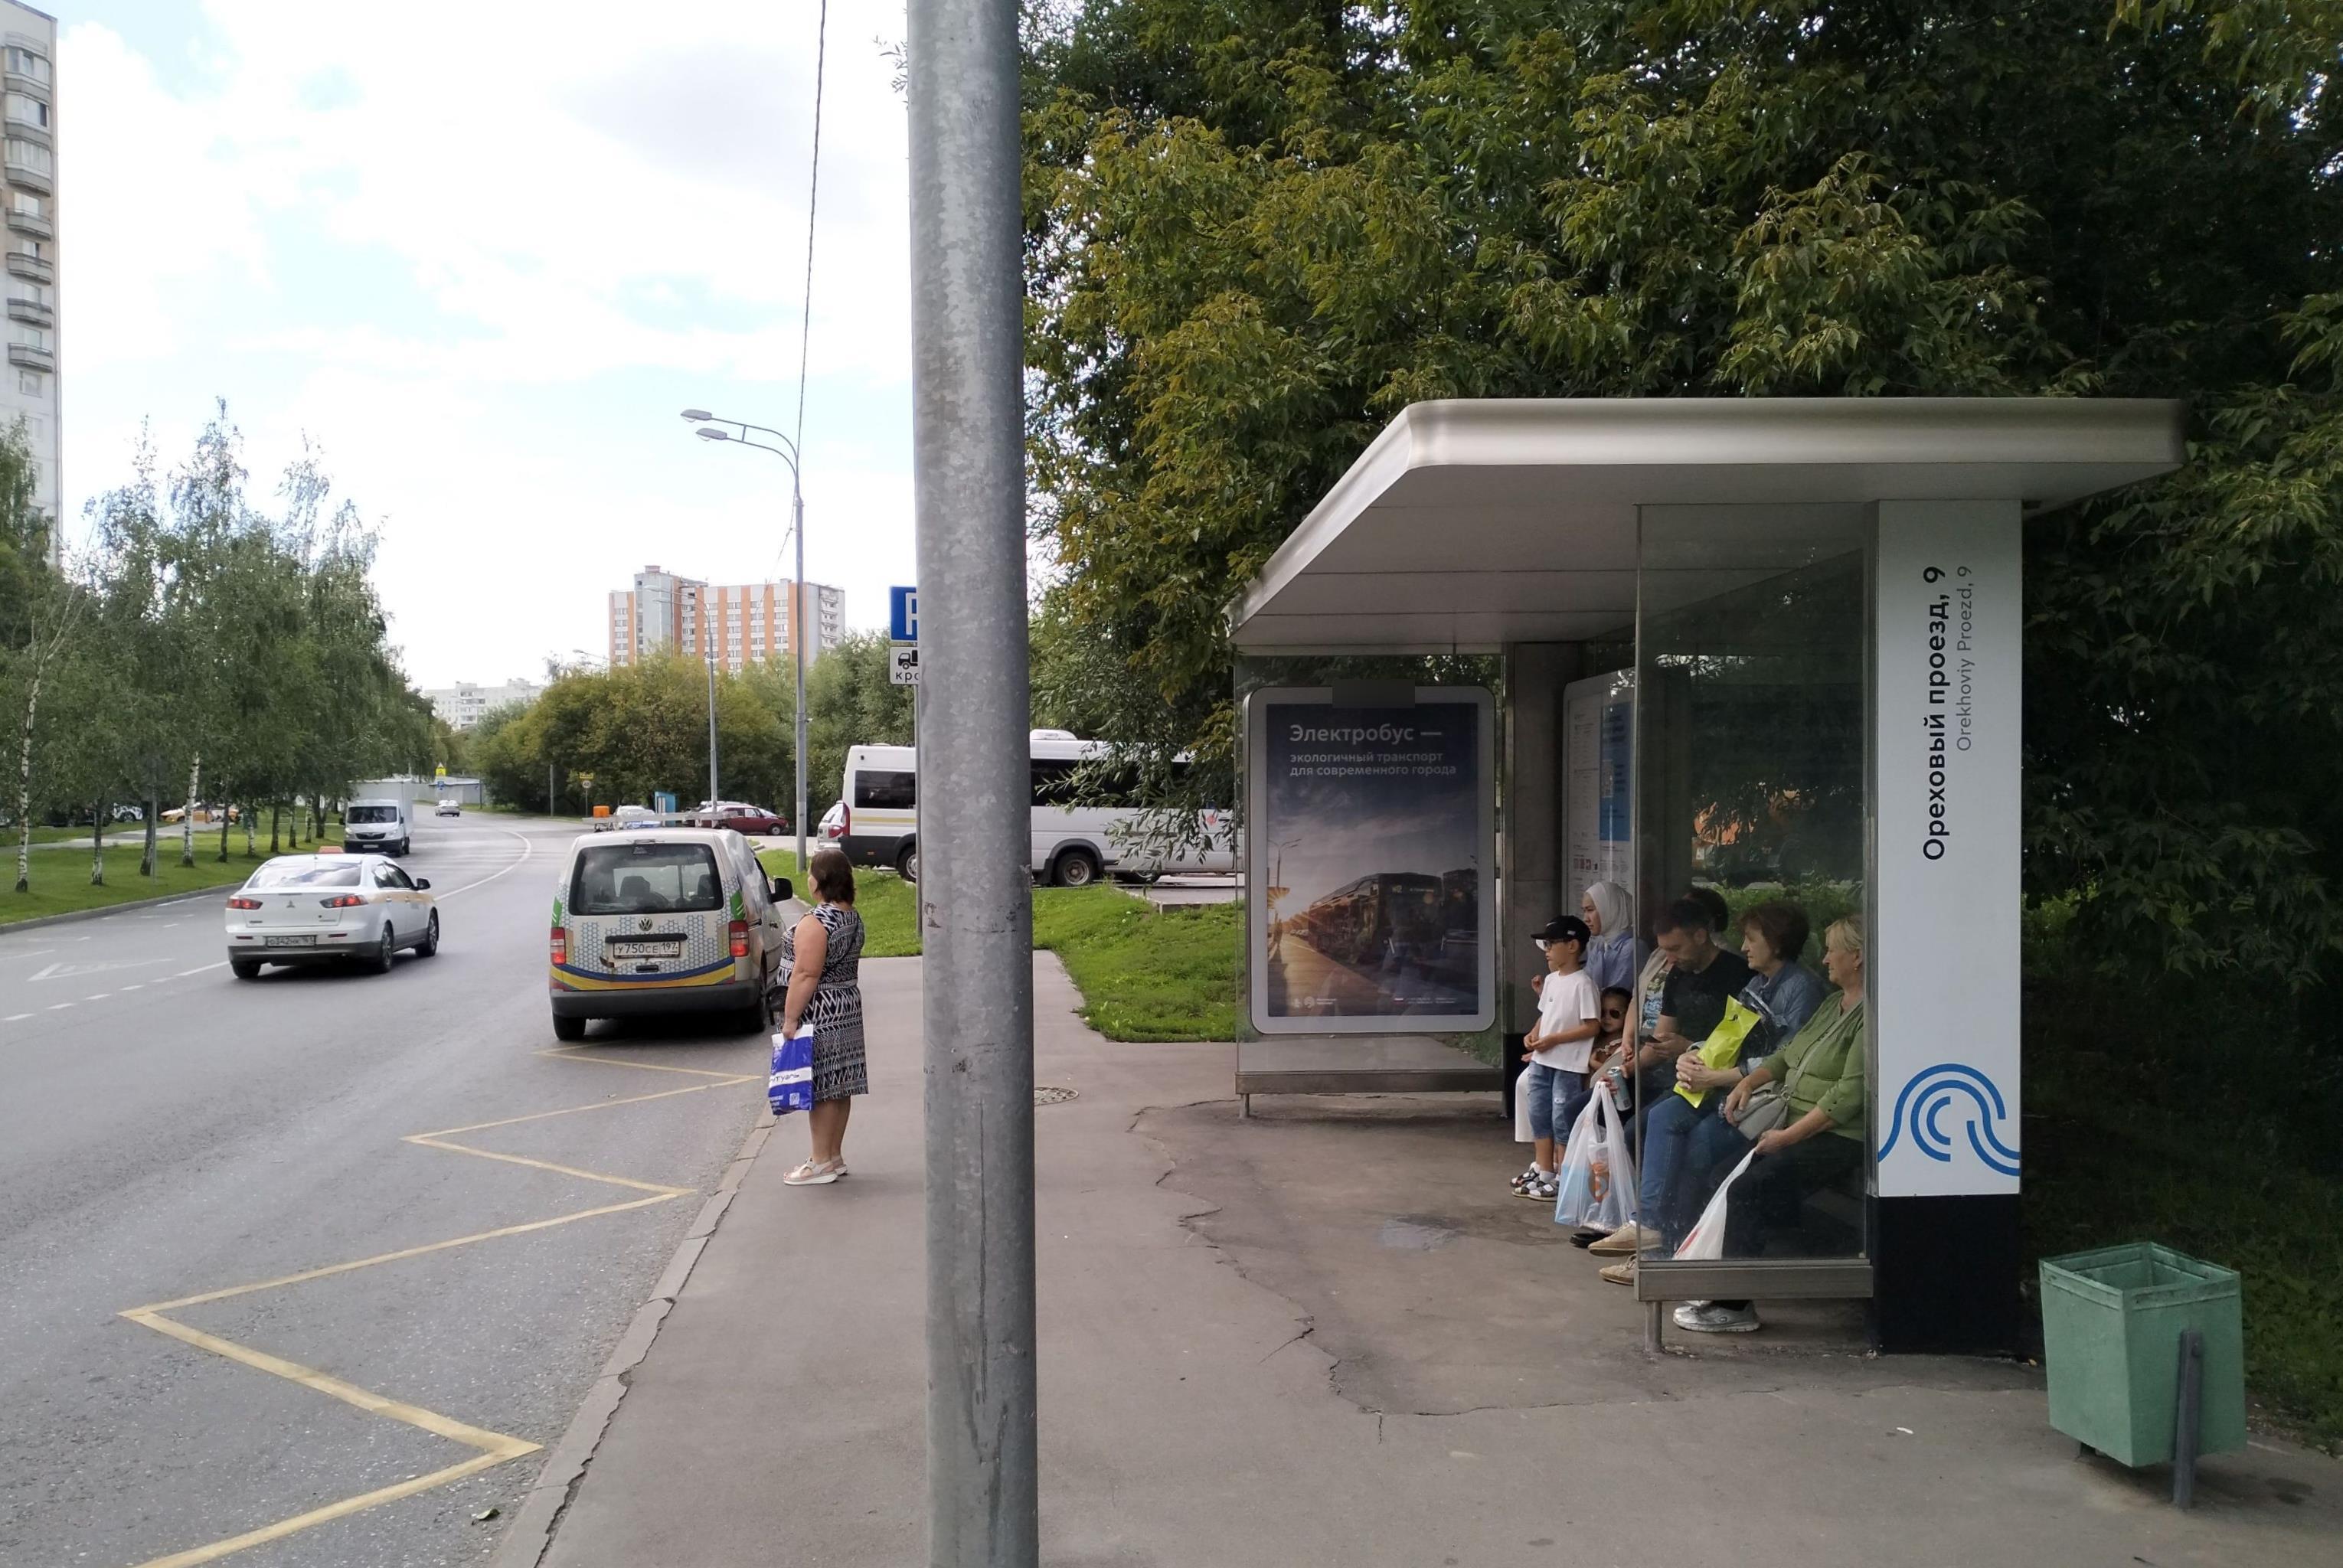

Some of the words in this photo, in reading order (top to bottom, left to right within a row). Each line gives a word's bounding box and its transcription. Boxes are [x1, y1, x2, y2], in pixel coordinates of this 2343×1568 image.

[1923, 566, 1946, 583] 9
[1957, 566, 1972, 577] 9
[1956, 583, 1974, 651] Proezd,
[1929, 594, 1950, 704] проезд,
[1956, 658, 1975, 751] Orekhoviy
[1289, 724, 1414, 744] Электробус
[1289, 751, 1374, 763] экологичный
[1377, 752, 1444, 764] транспорт
[1289, 766, 1314, 777] для
[1316, 766, 1410, 778] современного
[1412, 765, 1457, 777] города
[1923, 714, 1950, 861] Ореховый
